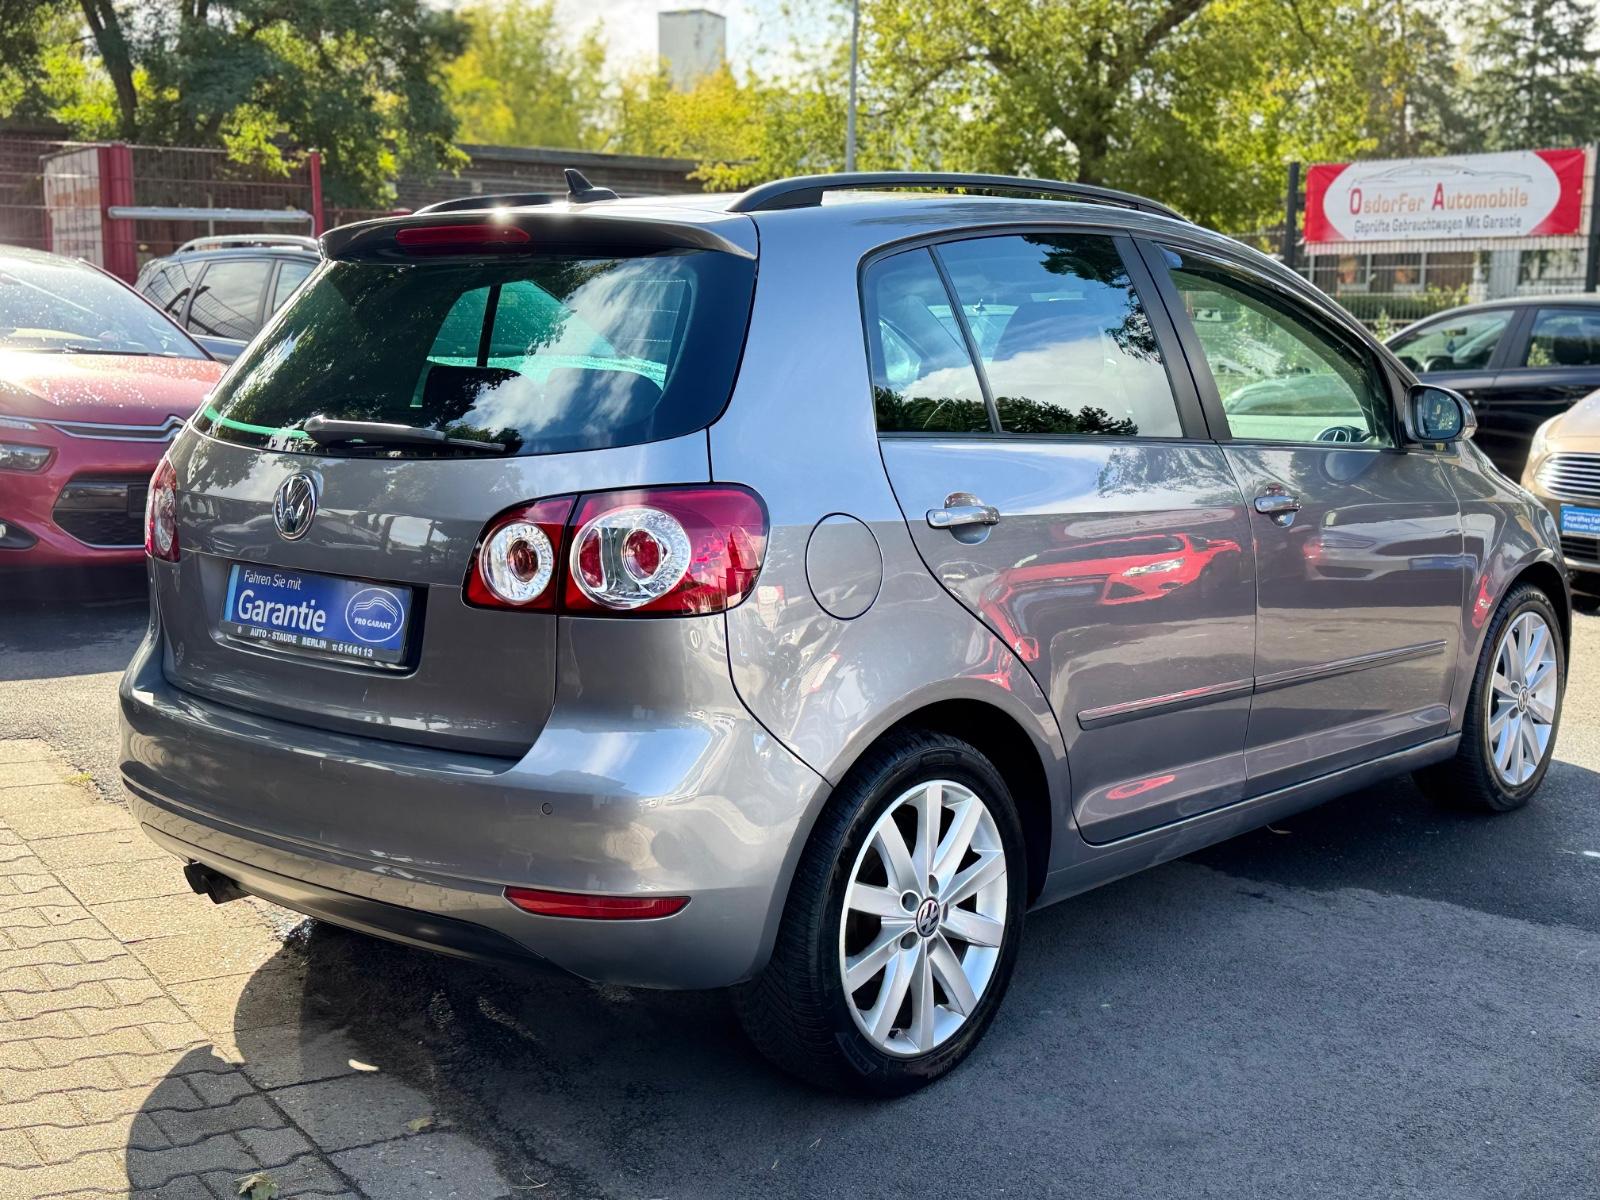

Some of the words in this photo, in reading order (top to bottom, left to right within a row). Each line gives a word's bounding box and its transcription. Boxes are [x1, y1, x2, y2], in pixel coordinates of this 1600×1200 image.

[1431, 182, 1529, 211] Automobile
[1354, 218, 1390, 236] Geprüfte
[1392, 215, 1462, 234] Gebrauchtwagen
[1466, 214, 1480, 229] Mit
[1482, 213, 1522, 229] Garantie
[244, 569, 271, 586] Fahren
[273, 574, 286, 588] Sie
[287, 578, 302, 591] mit
[238, 589, 326, 632] Garantie
[354, 617, 367, 626] PRO
[367, 620, 392, 631] GARANT
[250, 627, 267, 639] AUTO
[272, 633, 297, 644] STAUDE
[301, 636, 327, 649] BERLIN
